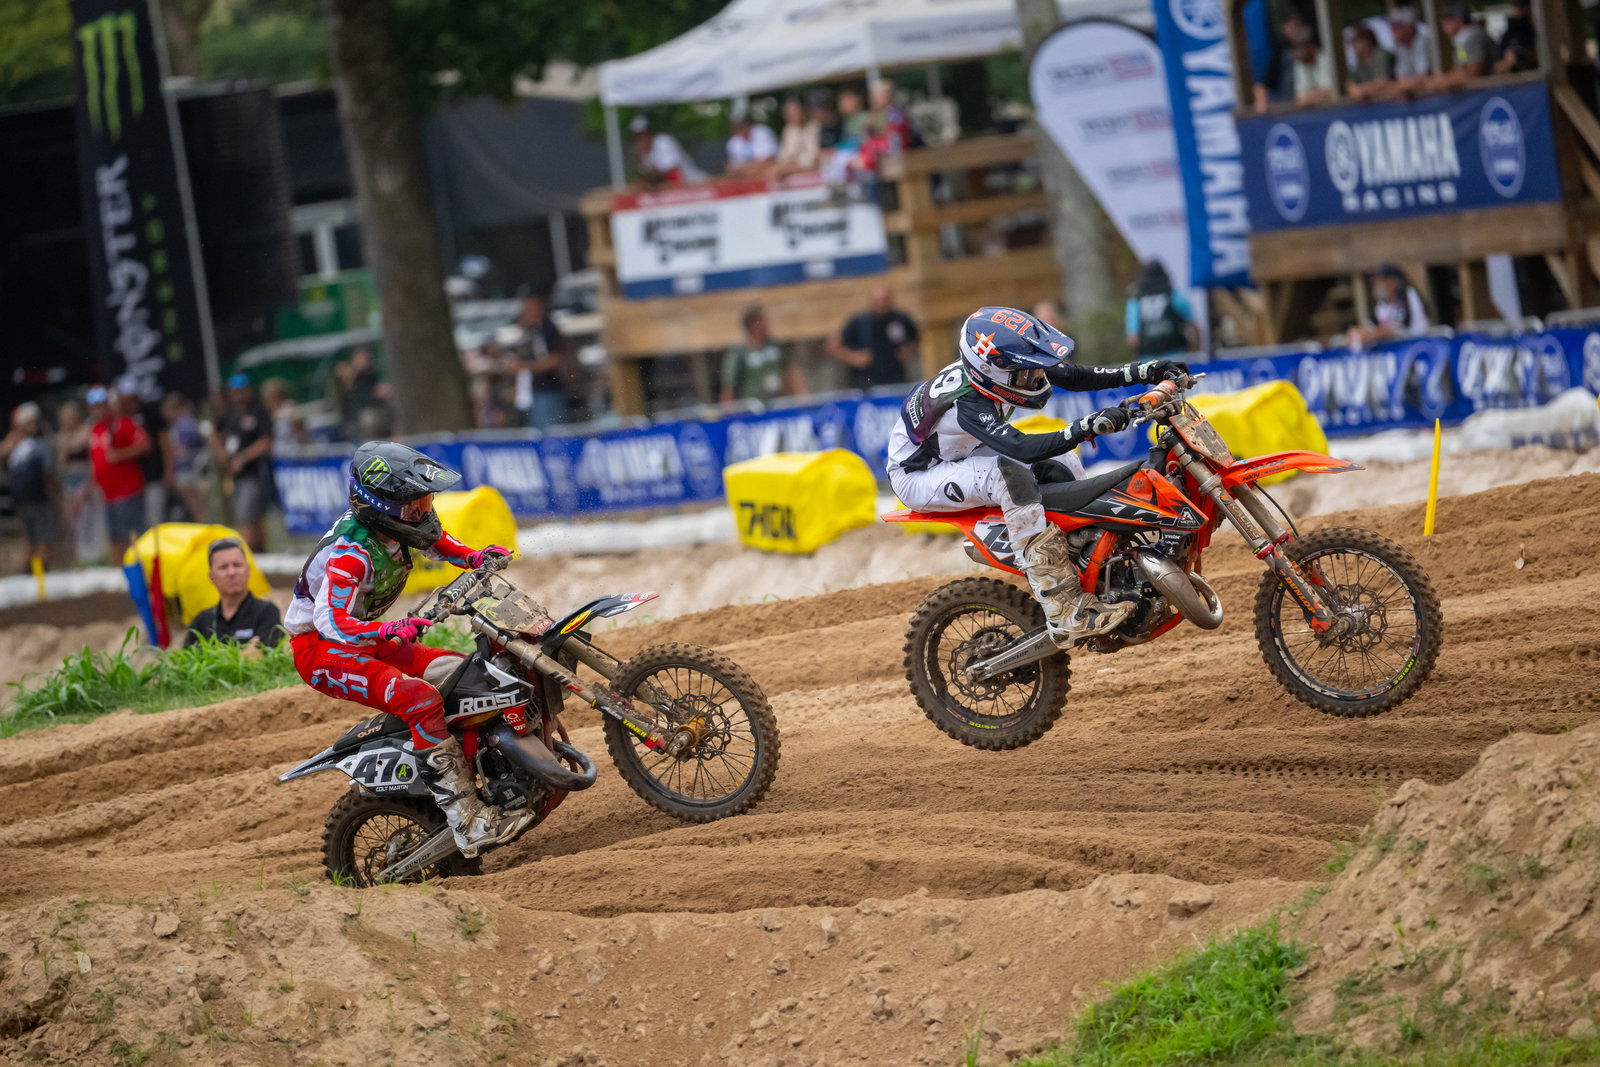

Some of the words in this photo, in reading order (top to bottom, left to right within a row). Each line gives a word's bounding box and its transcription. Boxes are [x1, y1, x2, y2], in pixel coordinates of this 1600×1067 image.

[1181, 42, 1252, 277] YAMAHA
[1353, 112, 1461, 186] YAMAHA
[1342, 180, 1457, 212] RACING
[991, 309, 1034, 335] 129
[1284, 576, 1316, 613] DUNLOP
[459, 688, 520, 716] ROOST
[352, 751, 402, 784] 47
[389, 784, 409, 792] MARTIN
[404, 852, 432, 870] DUNLOP
